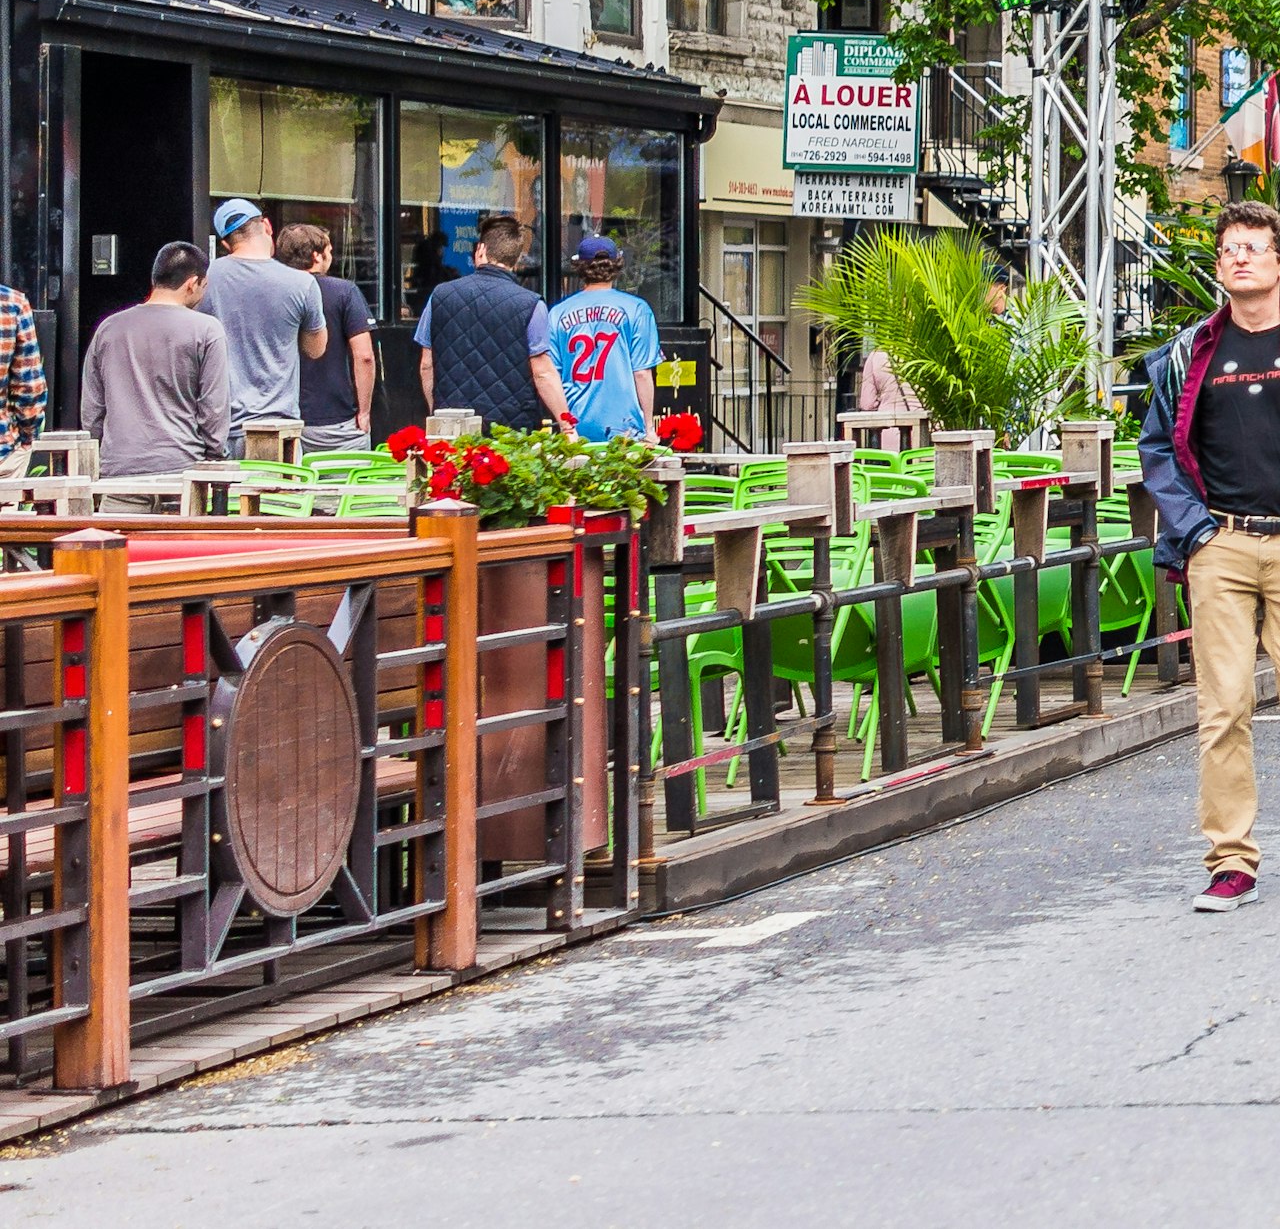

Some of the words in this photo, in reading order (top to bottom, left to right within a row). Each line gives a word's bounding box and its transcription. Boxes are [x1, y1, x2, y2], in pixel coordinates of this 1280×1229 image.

[793, 78, 811, 105] À
[821, 84, 912, 108] LOUER
[792, 113, 830, 129] LOCAL
[834, 114, 912, 131] COMMERCIAL
[808, 136, 839, 147] FRED
[842, 138, 898, 149] NARDELLI
[803, 150, 847, 161] 726-2929
[867, 152, 911, 163] 594-1498
[799, 174, 851, 187] TERRASSE
[808, 190, 833, 201] BACK
[842, 191, 894, 204] TERRASSE
[561, 305, 626, 331] GUERRERO
[568, 331, 620, 383] 27
[1213, 374, 1237, 385] NINE
[1239, 373, 1264, 382] INCH
